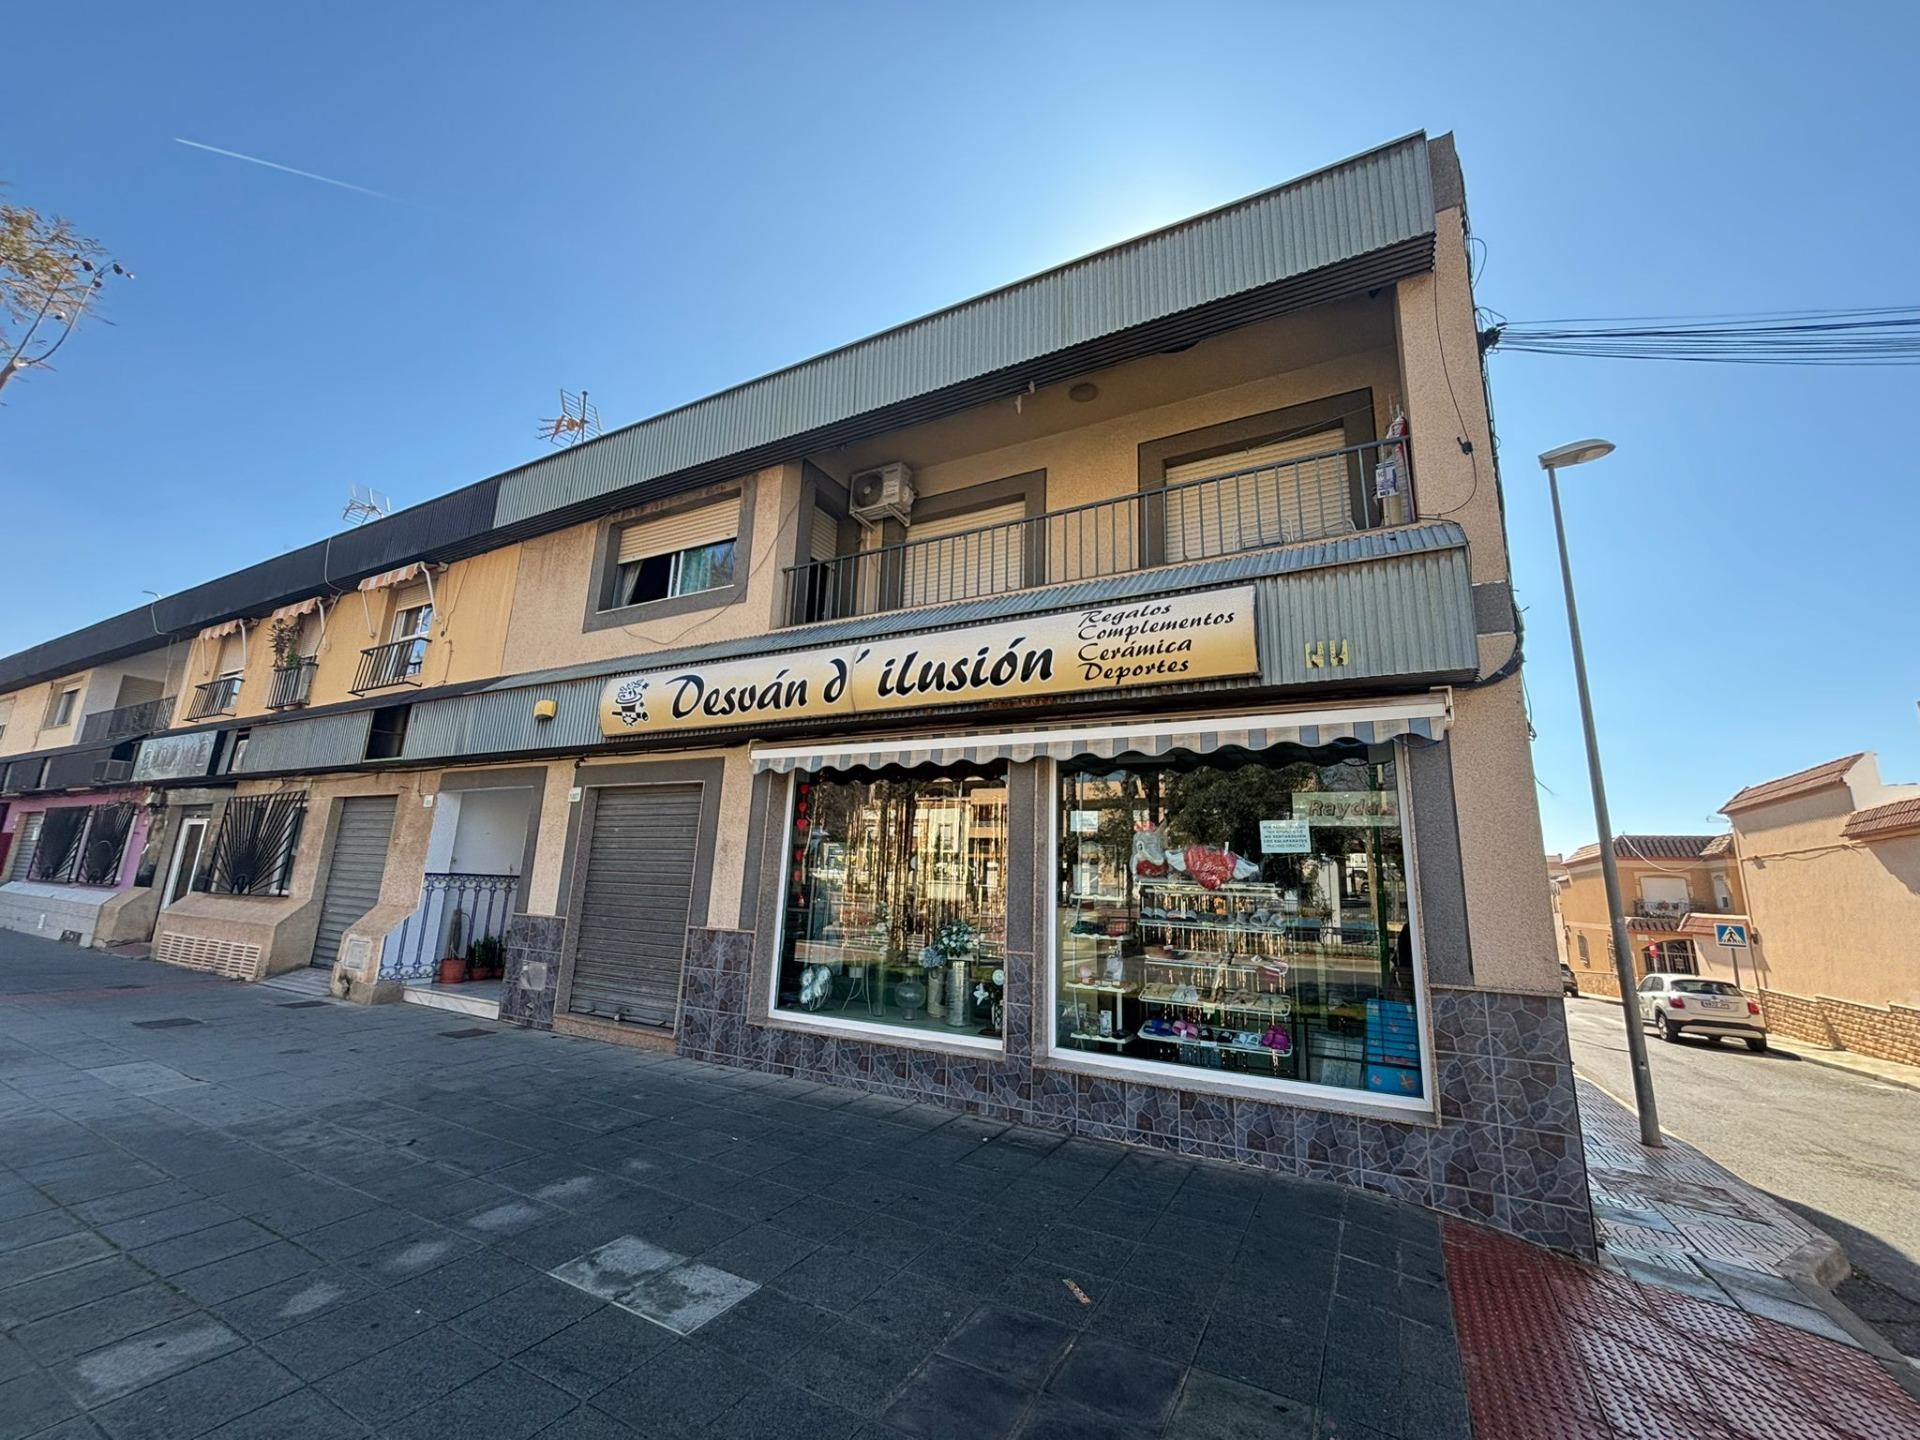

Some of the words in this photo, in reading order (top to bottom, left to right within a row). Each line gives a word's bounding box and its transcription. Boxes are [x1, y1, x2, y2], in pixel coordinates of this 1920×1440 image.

[1078, 604, 1171, 627] Regalos
[1078, 612, 1235, 643] Complementos
[1077, 638, 1192, 662] Cerámica
[665, 669, 808, 719] Desván
[878, 637, 1053, 697] ilusión
[1077, 659, 1189, 685] Deportes
